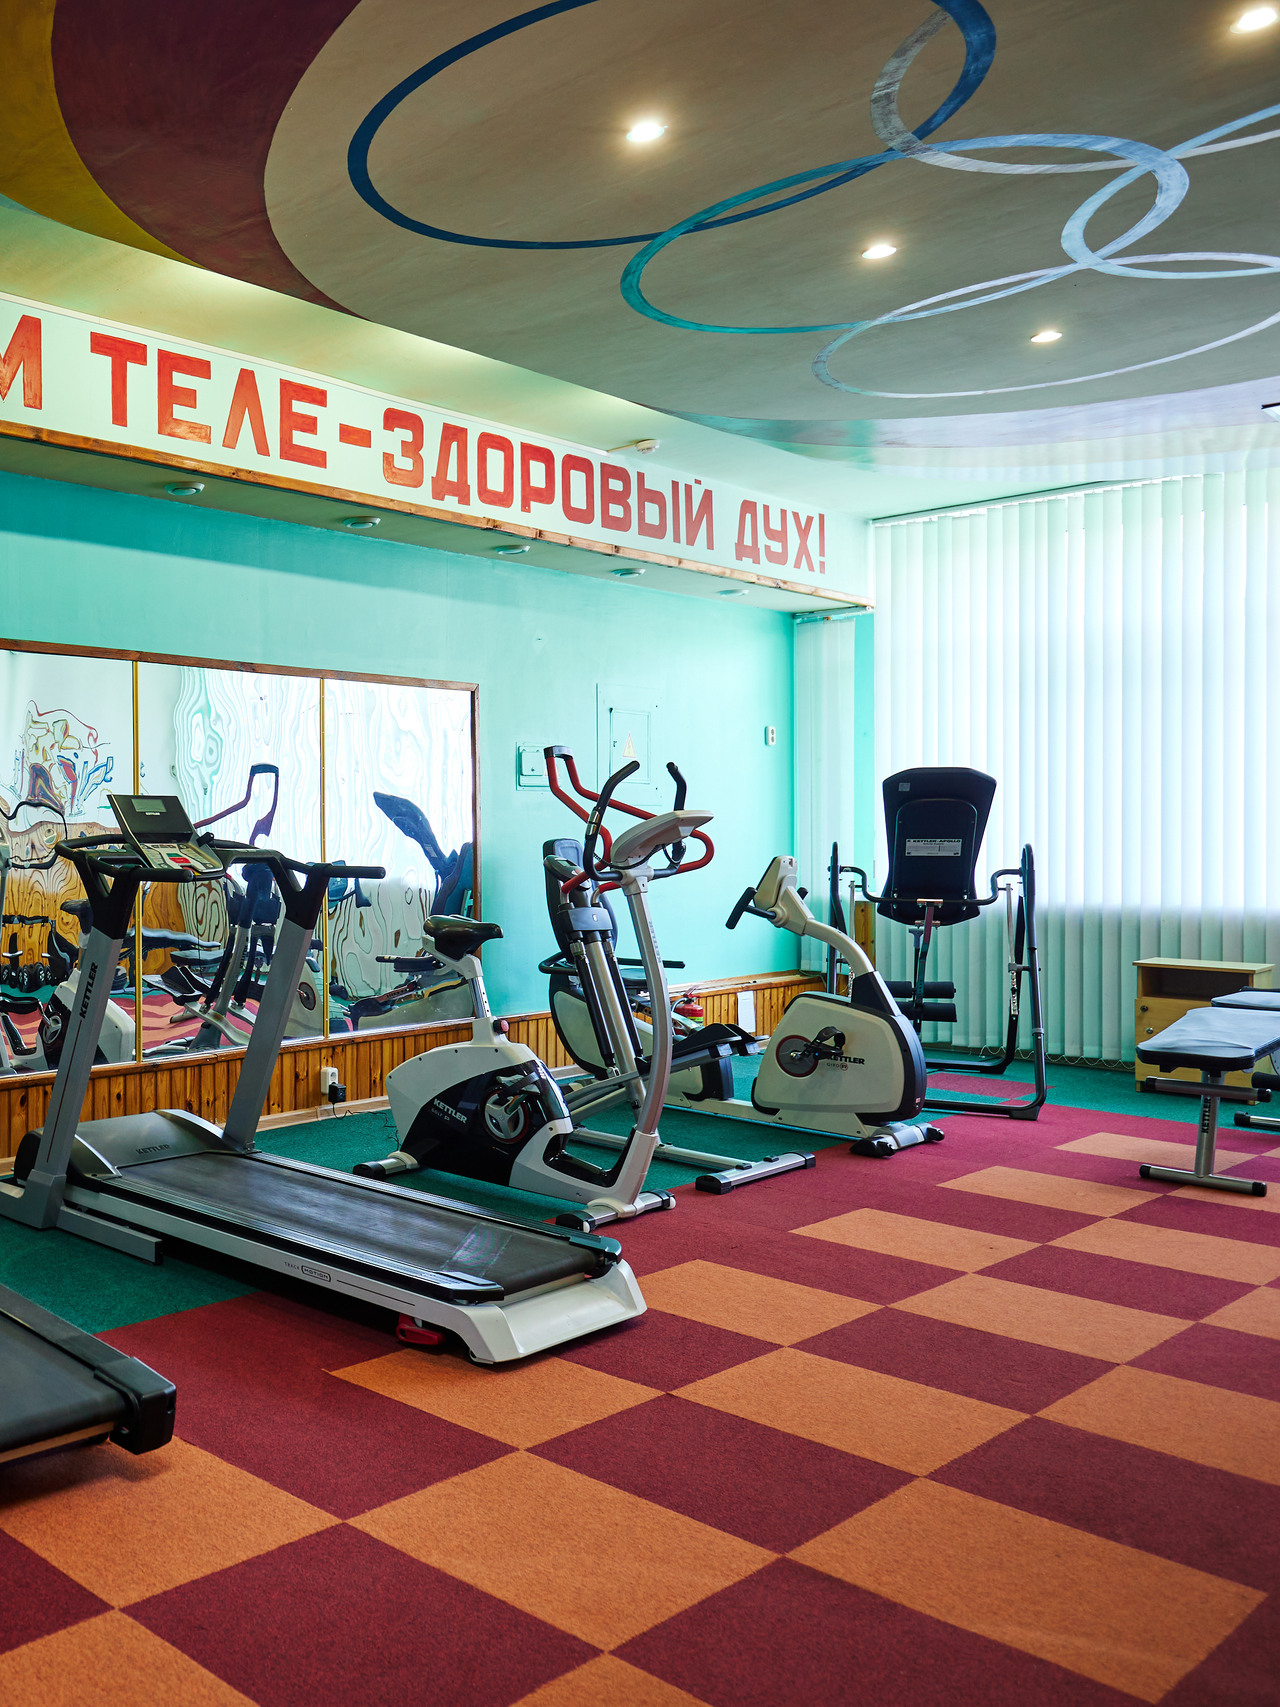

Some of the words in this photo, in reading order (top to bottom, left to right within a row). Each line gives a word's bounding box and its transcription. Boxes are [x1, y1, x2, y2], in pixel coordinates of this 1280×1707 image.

[734, 499, 827, 575] ДУХ!
[79, 961, 99, 1019] KETTLER
[433, 1098, 468, 1124] KETTLER
[1201, 1096, 1212, 1134] KETTLER
[135, 1144, 171, 1155] KETTLER
[303, 1267, 329, 1280] MOTION
